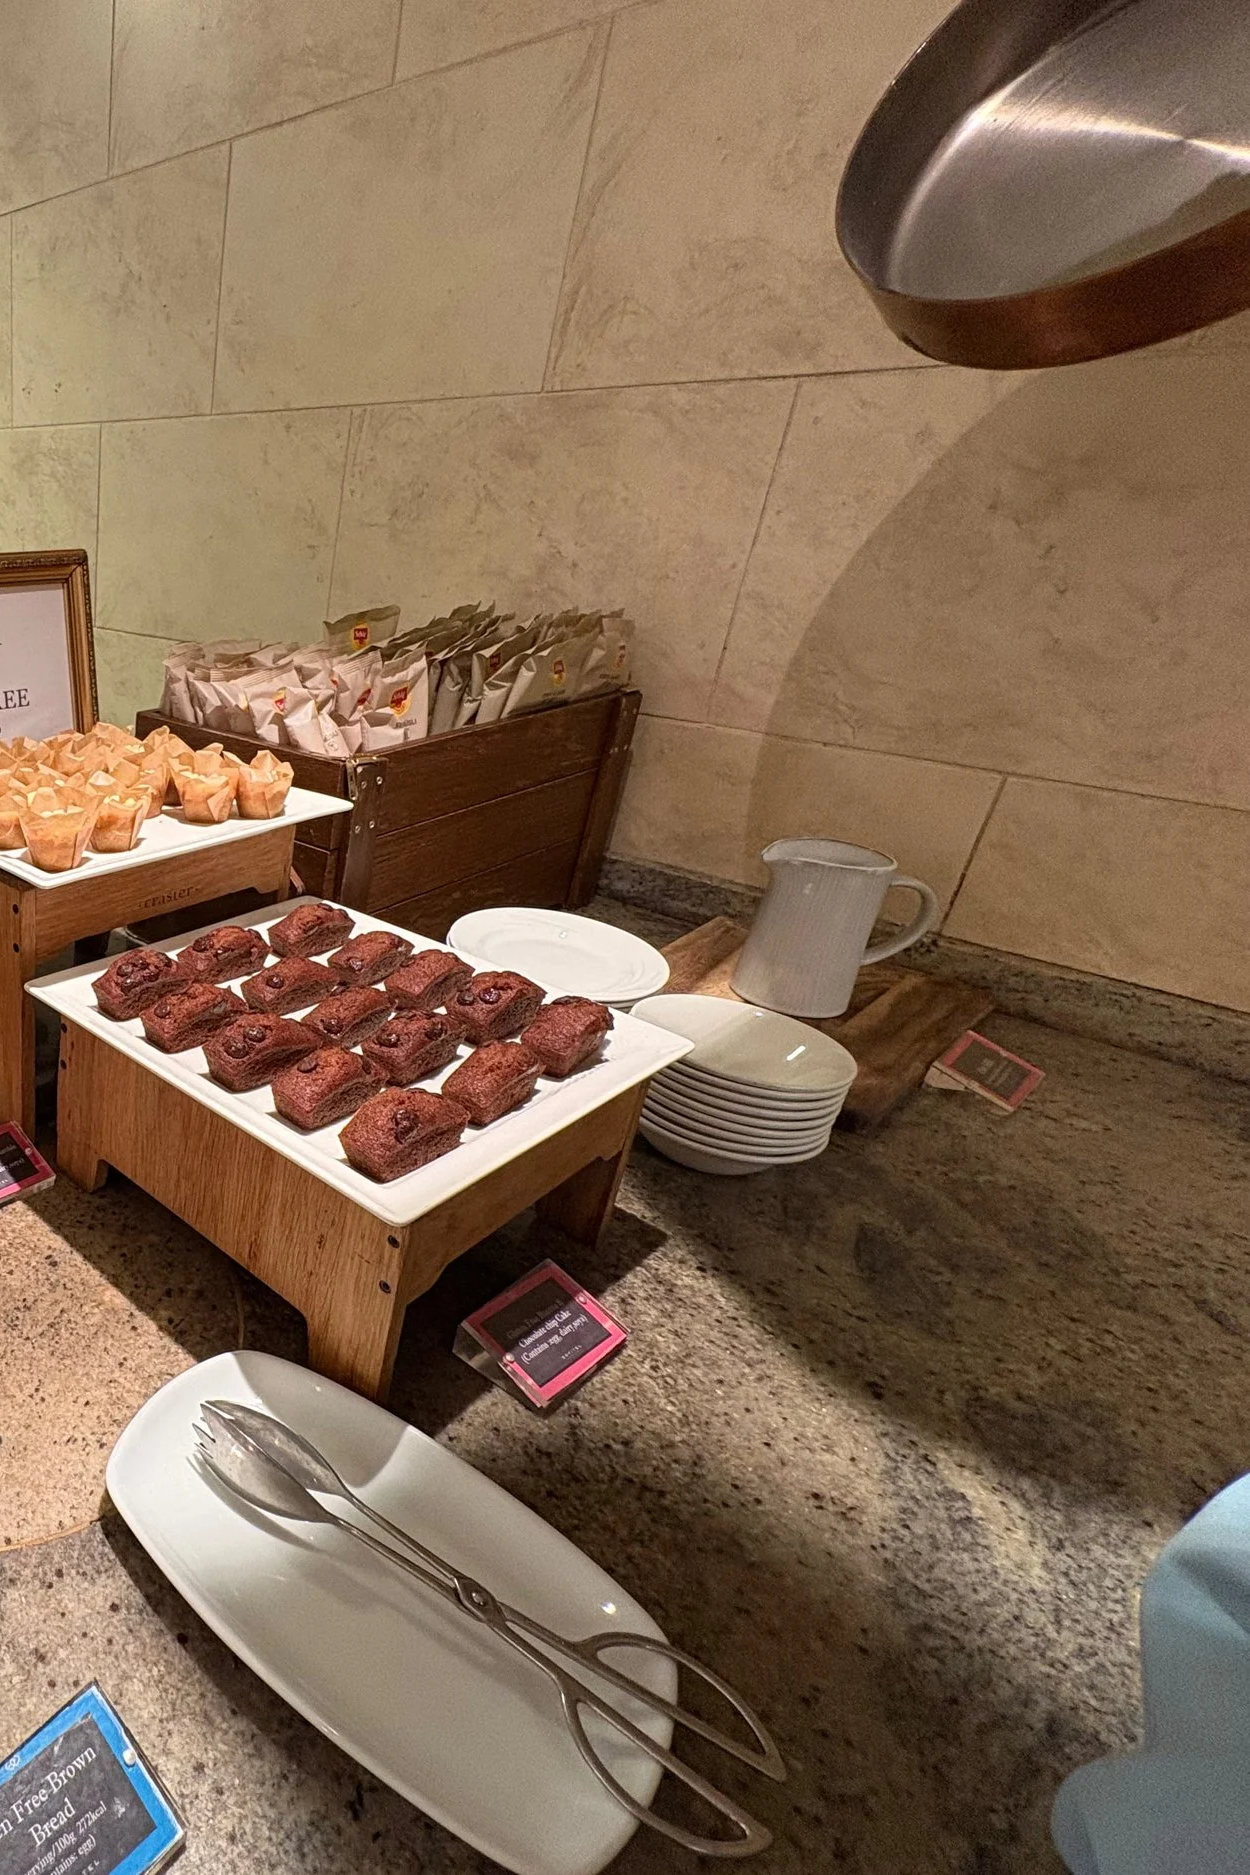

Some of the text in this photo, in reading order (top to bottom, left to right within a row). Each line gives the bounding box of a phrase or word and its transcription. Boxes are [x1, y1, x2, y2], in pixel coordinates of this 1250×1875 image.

[519, 1327, 547, 1348] Chocolate
[554, 1310, 572, 1322] Cake
[10, 1789, 49, 1824] Free
[44, 1747, 97, 1794] Brown
[28, 1796, 76, 1848] Bread
[75, 1800, 107, 1836] 272kcal
